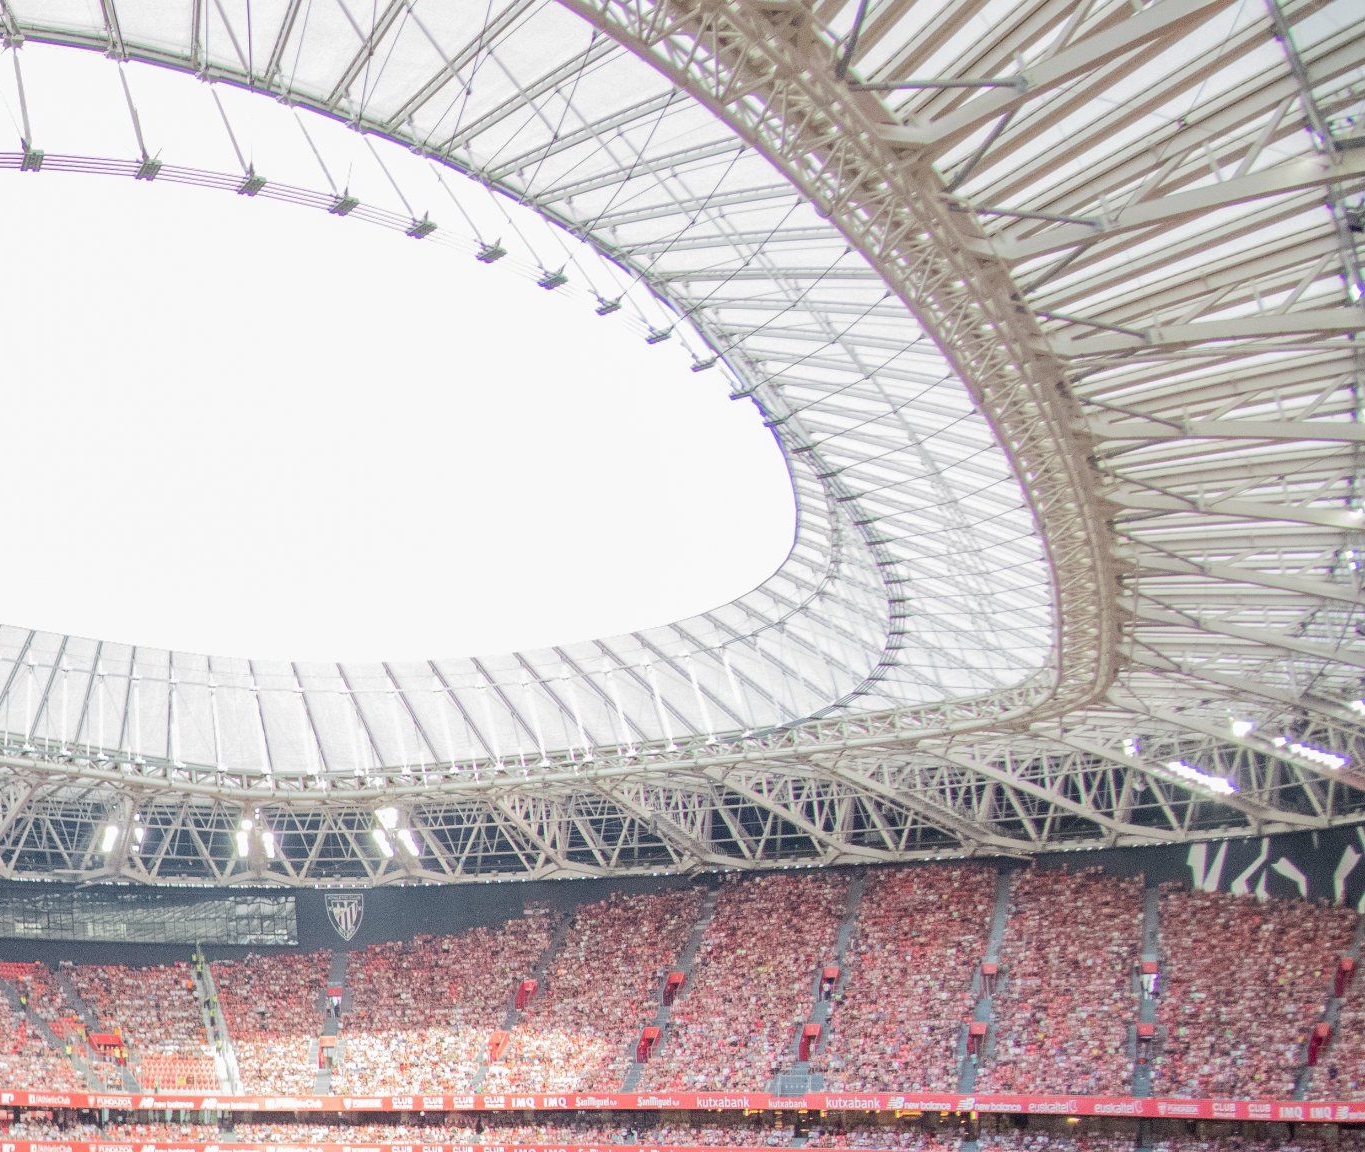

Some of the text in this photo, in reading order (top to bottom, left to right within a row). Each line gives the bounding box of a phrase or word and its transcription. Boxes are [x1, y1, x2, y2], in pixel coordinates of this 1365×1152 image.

[511, 1097, 535, 1107] IMQ
[543, 1097, 567, 1107] IMQ
[696, 1097, 749, 1109] kutxabank
[769, 1099, 807, 1109] kutxabank
[826, 1098, 880, 1110] kutxabank
[1029, 1101, 1069, 1112] euskaltel
[1094, 1103, 1134, 1113] euskaltel
[1279, 1107, 1304, 1119] IMQ
[1310, 1107, 1333, 1119] IMQ
